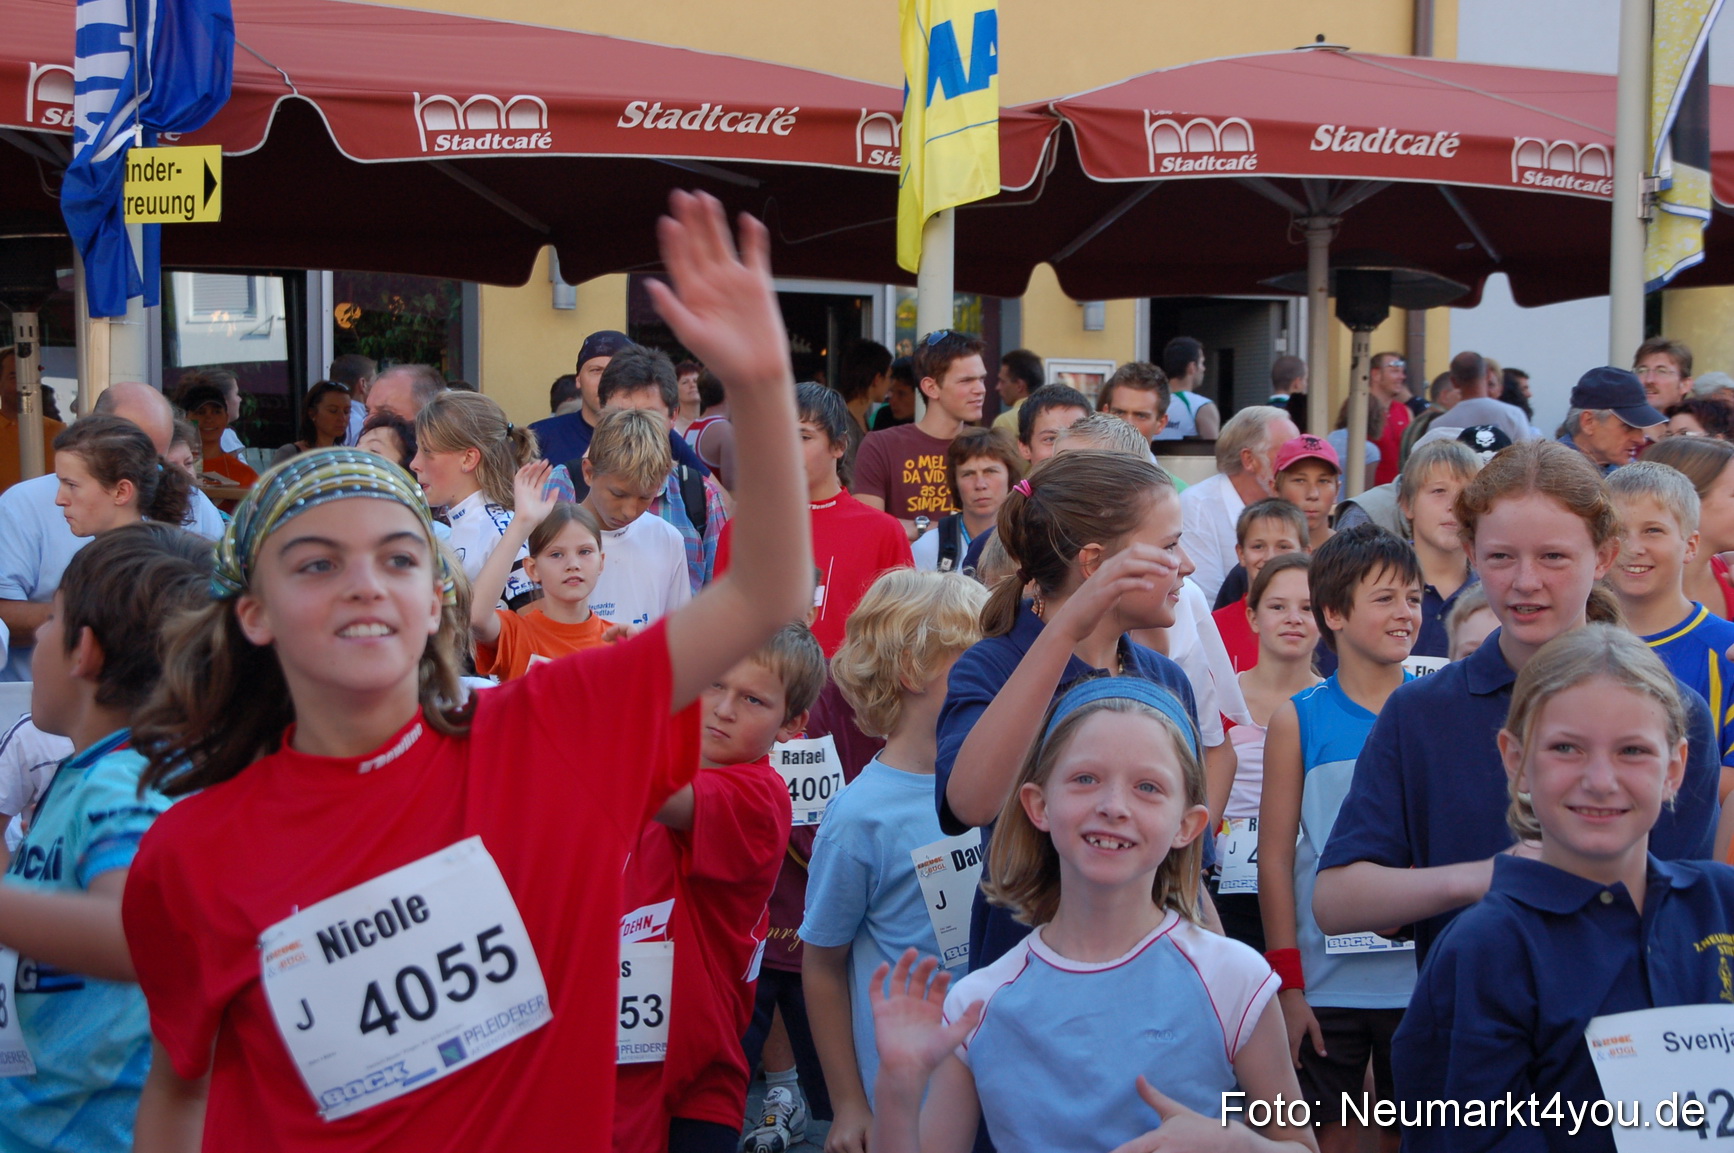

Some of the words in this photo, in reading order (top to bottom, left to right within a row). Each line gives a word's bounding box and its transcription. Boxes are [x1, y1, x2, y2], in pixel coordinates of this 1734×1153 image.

[617, 100, 799, 136] Stadtcafé
[434, 132, 552, 151] Stadtcafé
[1310, 124, 1461, 158] Stadtcafé
[1160, 154, 1258, 173] Stadtcafé
[1522, 170, 1613, 195] Stadtcafé
[903, 470, 921, 483] DA
[924, 470, 947, 483] VID
[921, 485, 936, 497] as
[781, 748, 825, 765] Rafael
[788, 773, 840, 802] 4007
[1229, 841, 1236, 855] J
[935, 890, 947, 910] J
[316, 894, 430, 965] Nicole
[623, 914, 654, 937] DEHN
[1328, 936, 1375, 948] BOCK
[296, 998, 315, 1031] J
[359, 924, 518, 1036] 4055
[463, 993, 546, 1045] PFLEIDERER
